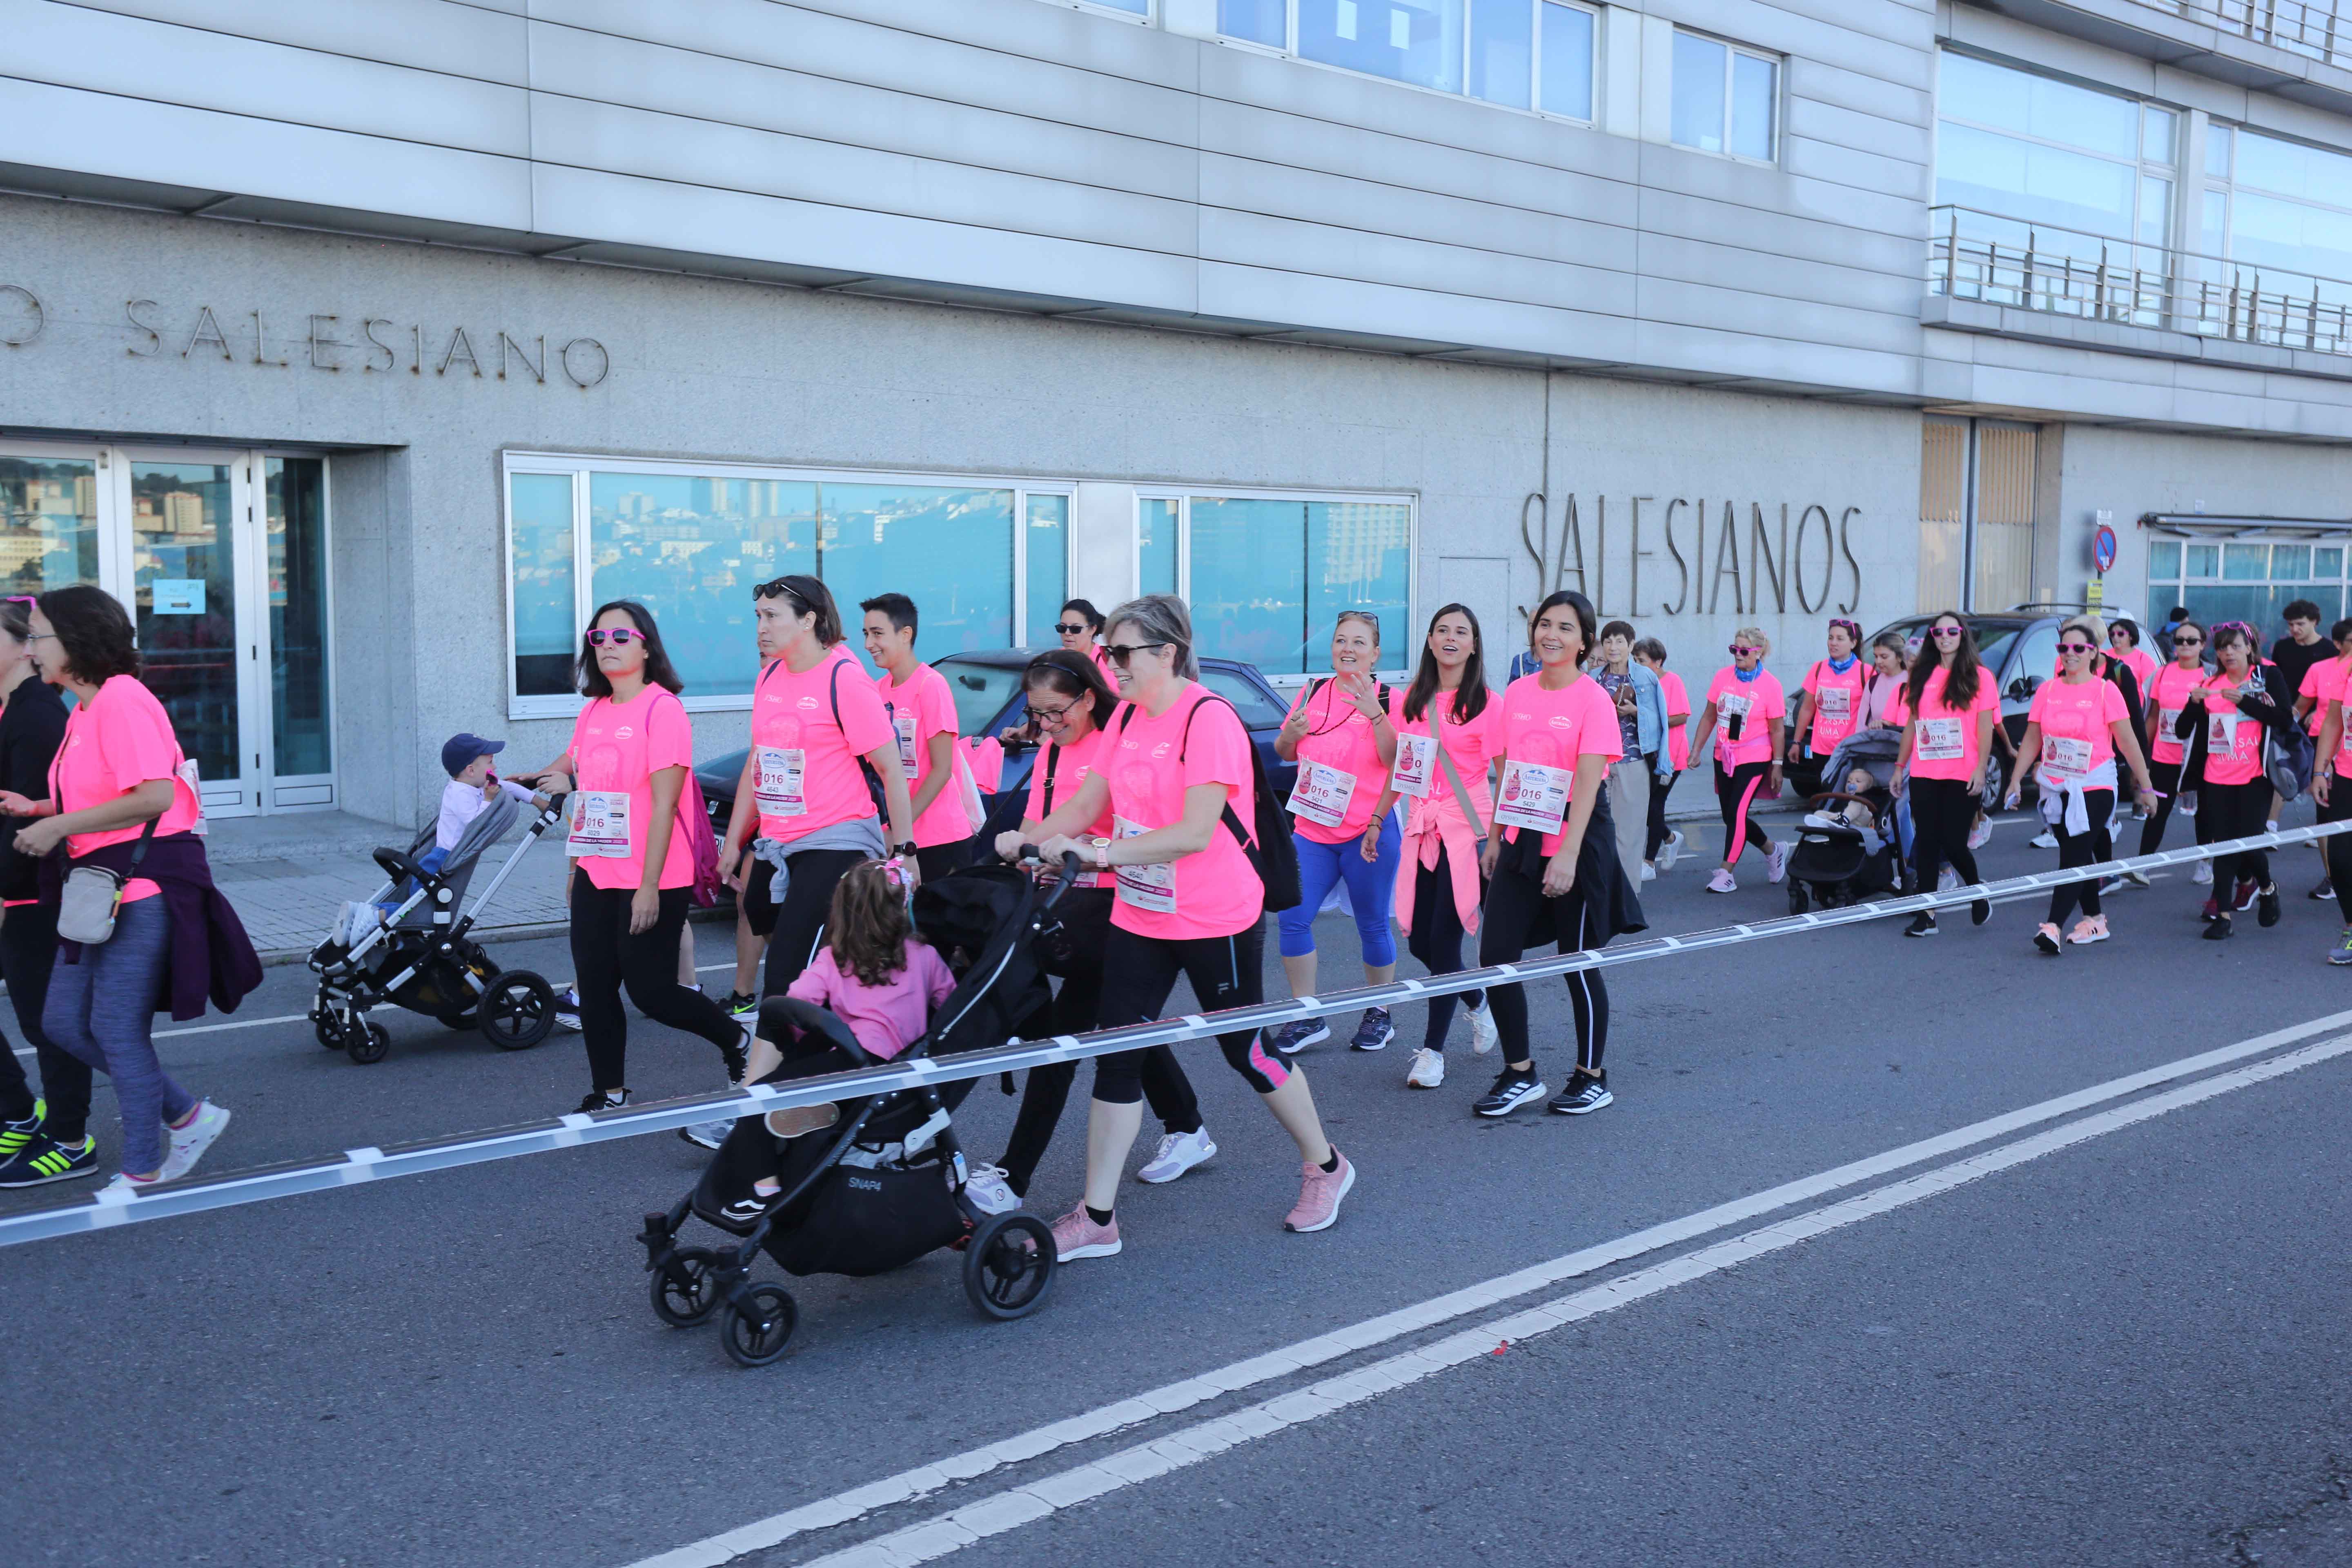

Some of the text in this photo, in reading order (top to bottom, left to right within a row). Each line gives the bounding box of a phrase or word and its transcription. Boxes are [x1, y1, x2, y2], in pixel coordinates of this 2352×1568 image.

[126, 298, 610, 388] SALESIANO
[1518, 492, 1862, 618] SALESIANOS
[1819, 727, 1839, 735] UMA
[2058, 753, 2072, 762] 016
[764, 773, 784, 784] 016
[1311, 785, 1329, 797] 016
[1521, 788, 1541, 800] 016
[586, 818, 604, 827] 016
[848, 1177, 882, 1192] SNAP4
